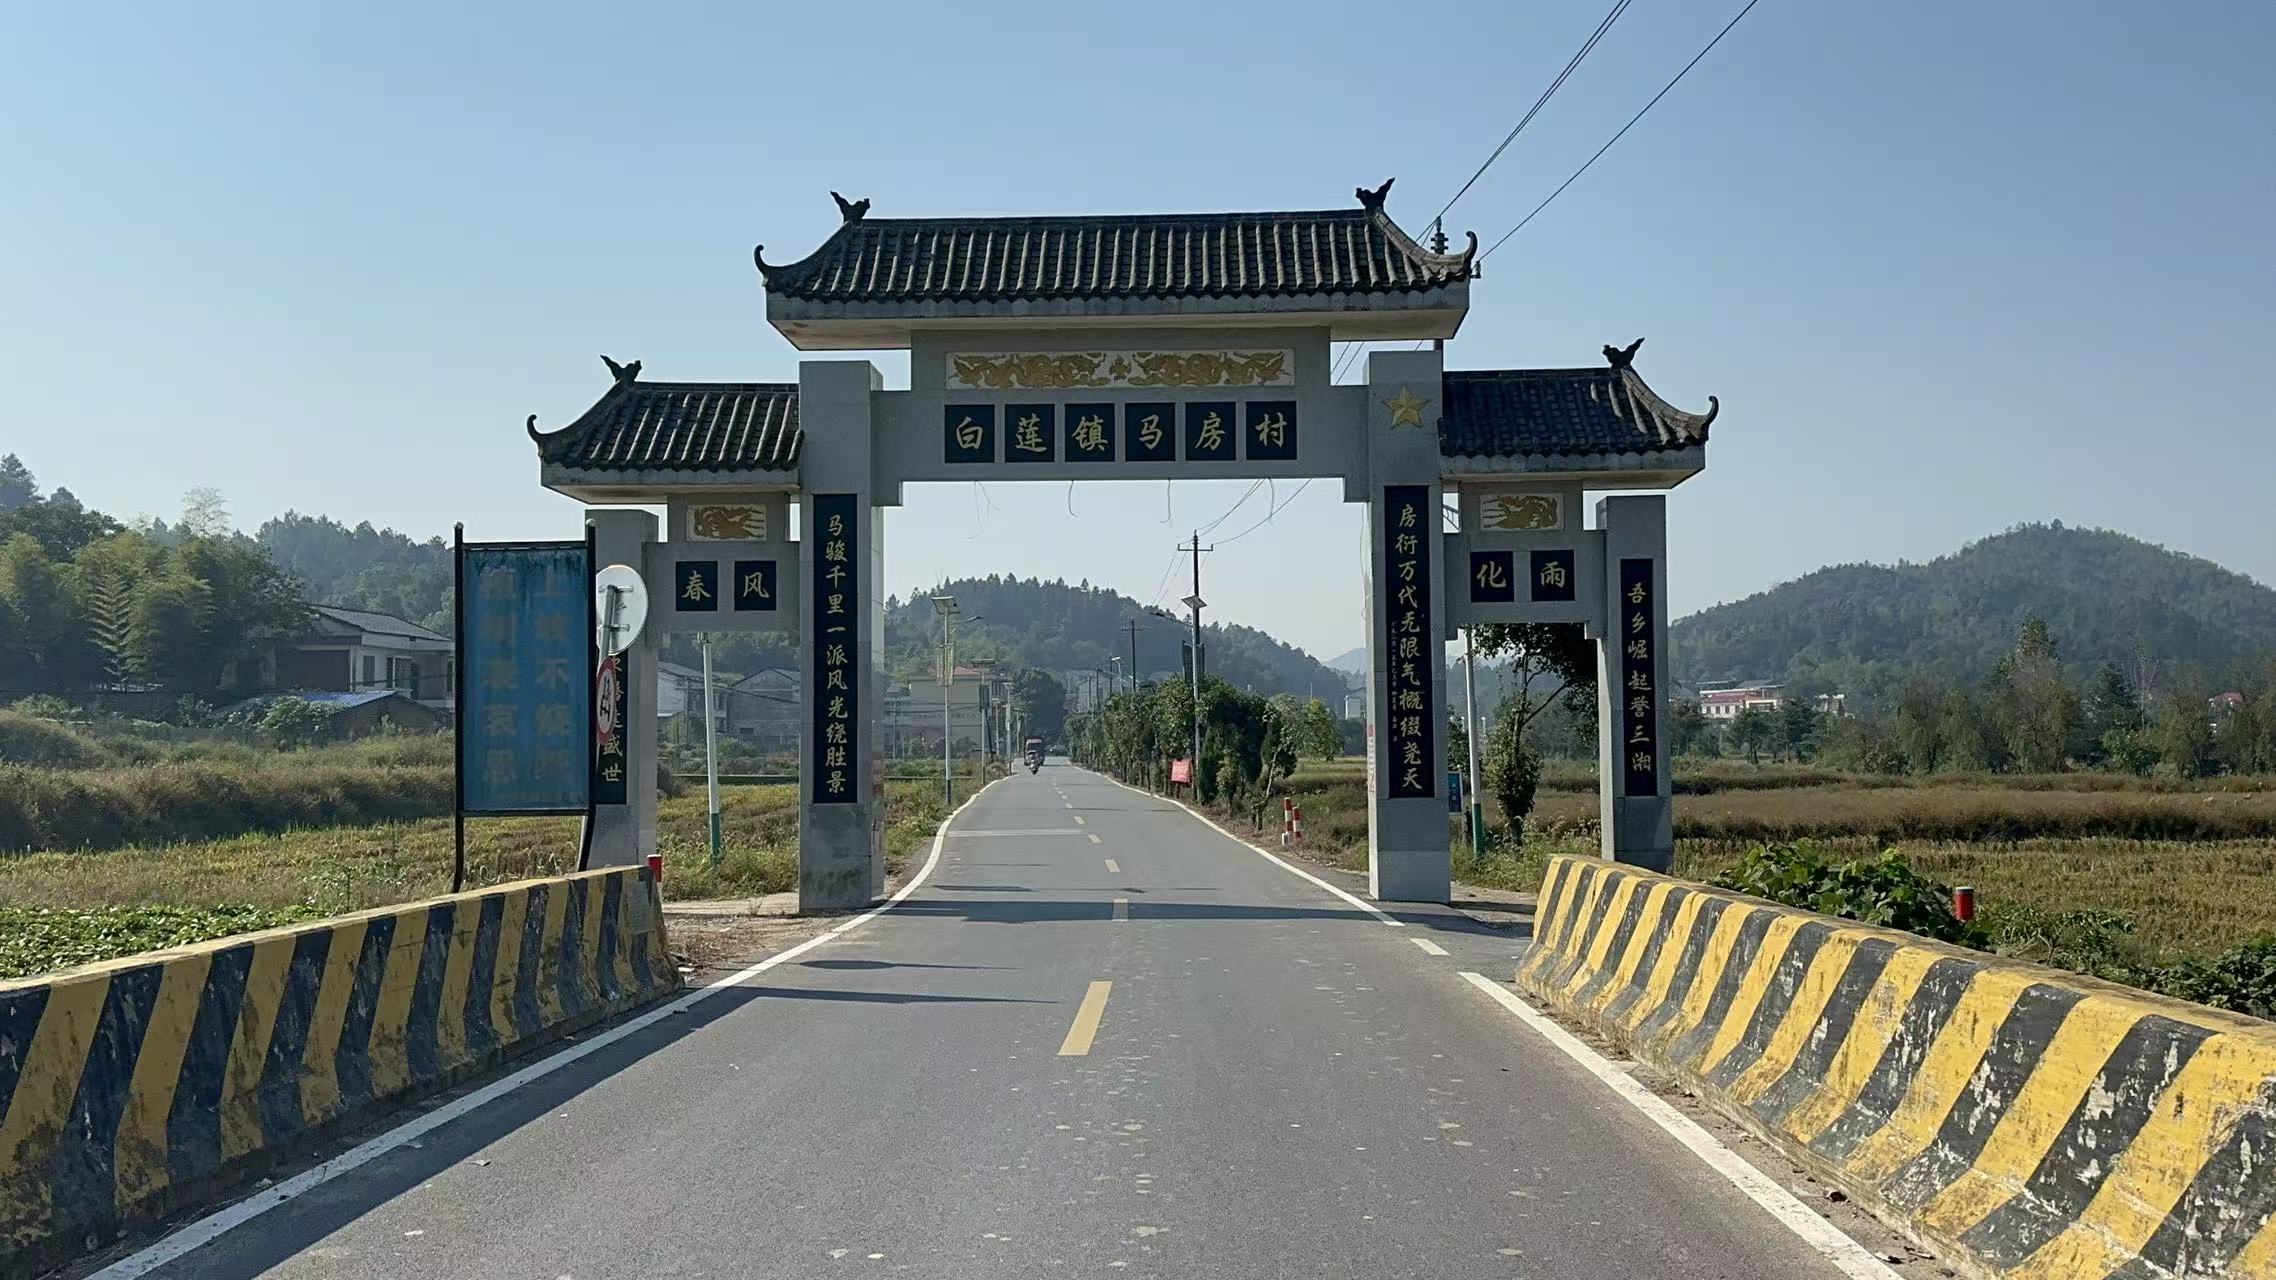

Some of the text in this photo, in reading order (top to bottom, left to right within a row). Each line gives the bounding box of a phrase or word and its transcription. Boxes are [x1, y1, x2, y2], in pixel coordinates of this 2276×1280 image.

[956, 411, 1287, 452] 白莲镇马房村
[682, 570, 770, 601] 春风
[1477, 560, 1565, 588] 化雨
[826, 514, 849, 794] 马骏千里一派风光绕胜景
[1628, 582, 1652, 772] 吾乡崛起誉三湘
